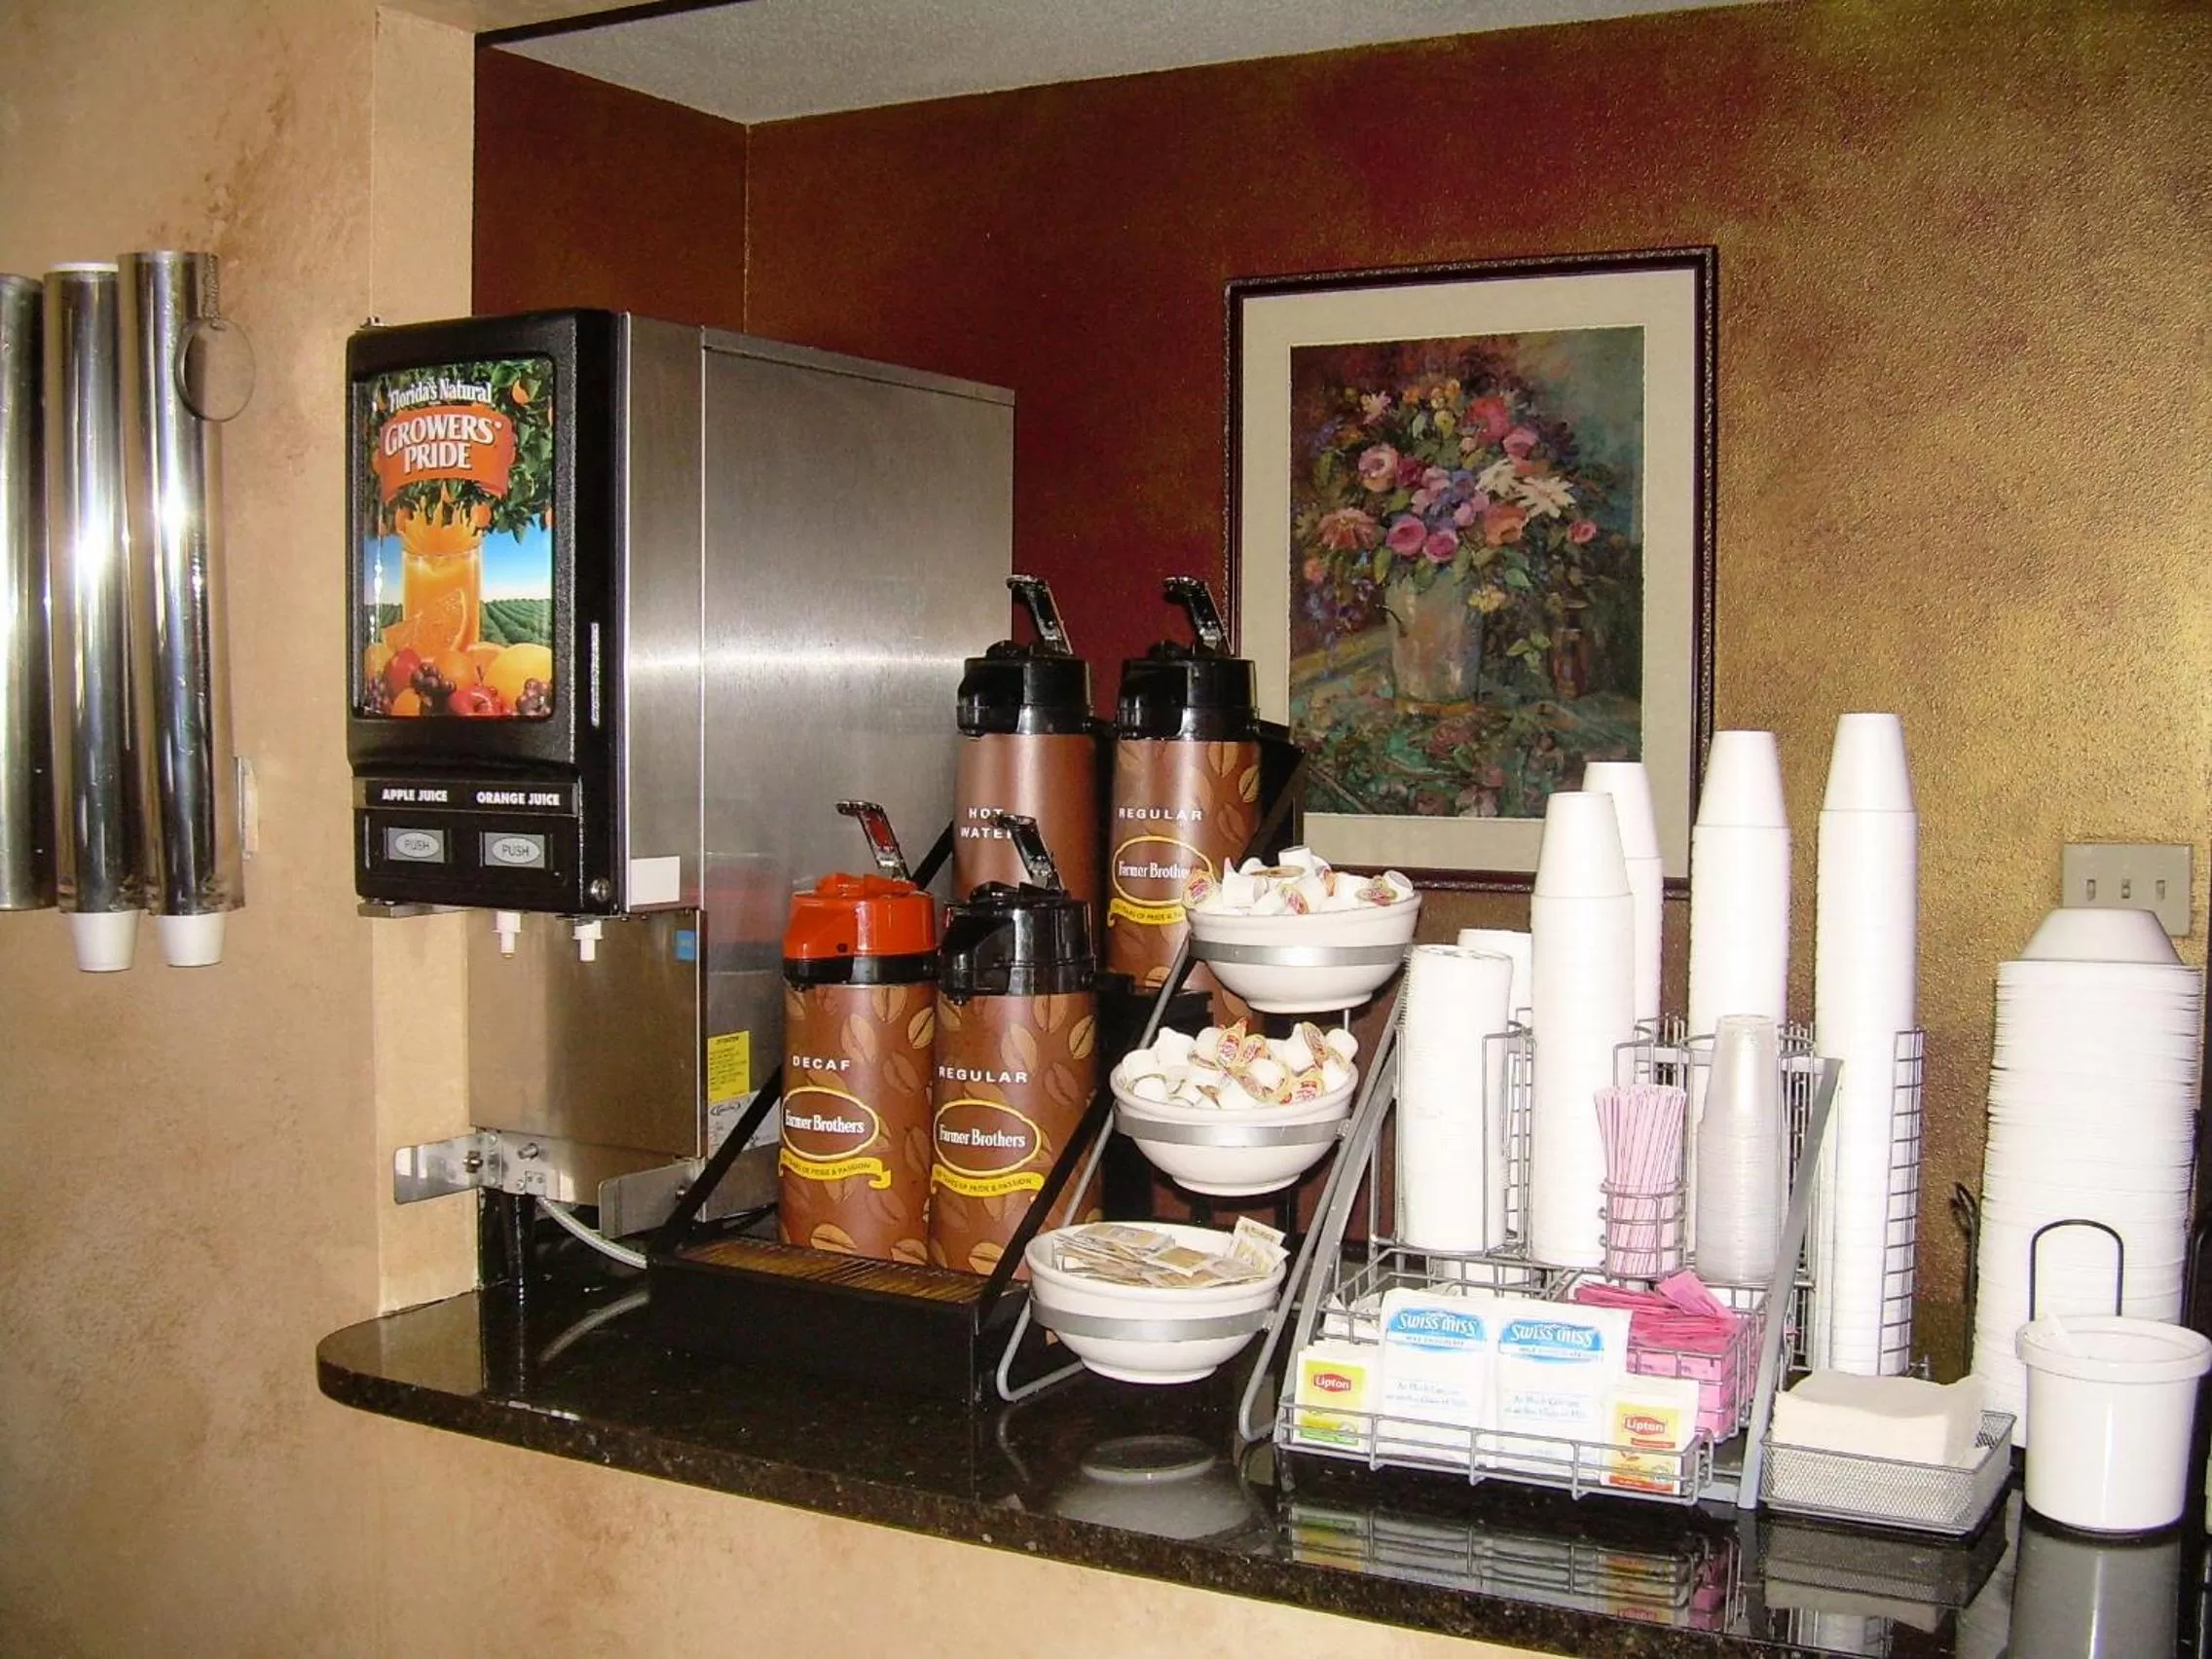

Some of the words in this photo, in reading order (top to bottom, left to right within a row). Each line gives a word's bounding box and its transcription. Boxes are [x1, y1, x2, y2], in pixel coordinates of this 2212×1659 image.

[389, 379, 438, 413] Florida's
[439, 378, 494, 404] Natural
[404, 442, 472, 473] PRIDE
[382, 789, 415, 802] APPLE
[417, 790, 449, 802] JUICE
[476, 792, 526, 805] ORANGE
[528, 793, 561, 806] JUICE
[1119, 807, 1203, 822] REGULAR
[404, 838, 430, 851] PUSH
[500, 844, 530, 858] PUSH
[1119, 860, 1149, 877] Farmer
[793, 1055, 851, 1071] DECAF
[939, 1065, 1029, 1084] REGULAR
[785, 1109, 813, 1129] Farmer
[813, 1114, 866, 1133] Brothers
[939, 1124, 971, 1145] Farmer
[971, 1127, 1026, 1147] Brothers
[1314, 1376, 1350, 1391] Lipton
[1626, 1417, 1665, 1434] Lipton
